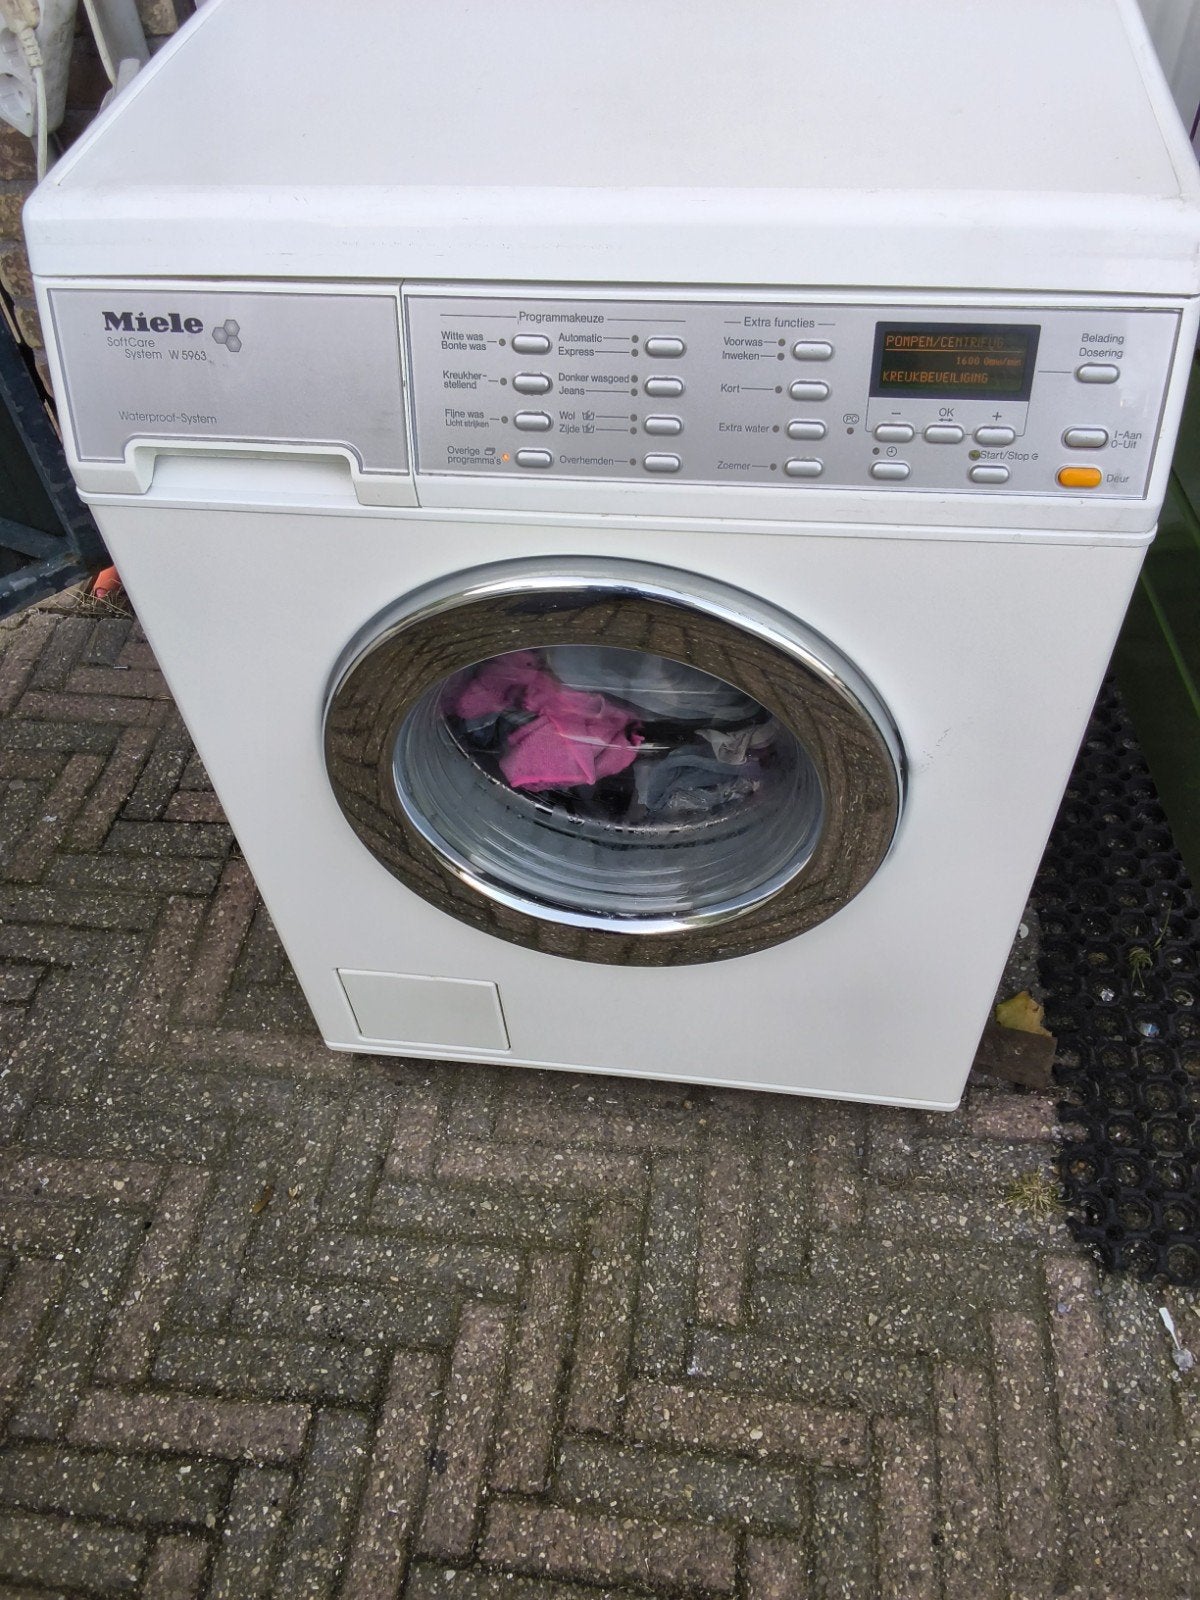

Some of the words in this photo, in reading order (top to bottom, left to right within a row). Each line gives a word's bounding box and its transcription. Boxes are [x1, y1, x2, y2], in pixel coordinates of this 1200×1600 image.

[102, 311, 204, 334] Miele
[519, 311, 605, 324] Programmakeuze
[743, 316, 771, 328] Extra
[774, 317, 815, 328] functies
[441, 330, 464, 341] Witte
[466, 333, 484, 341] was
[558, 332, 603, 343] Automatic
[1081, 332, 1125, 345] Belading
[107, 336, 155, 348] SoftCare
[441, 340, 467, 350] Bonte
[469, 343, 487, 351] was
[723, 336, 763, 347] Voorwas
[125, 348, 162, 360] System
[168, 350, 179, 360] W
[181, 350, 207, 361] 5963
[558, 346, 595, 357] Express
[722, 350, 760, 361] Inweken
[1079, 347, 1124, 359] Dosering
[955, 356, 980, 366] 1600
[442, 370, 487, 380] Kreukher-
[558, 372, 589, 382] Donker
[590, 374, 630, 385] wasgoed
[882, 370, 989, 384] KREUKBEVEILIGING
[444, 380, 477, 389] stellend
[720, 383, 740, 393] Kort
[558, 386, 585, 396] Jeans
[445, 408, 465, 419] Fijne
[467, 411, 485, 419] was
[559, 410, 576, 420] Wol
[938, 407, 955, 417] OK
[118, 411, 218, 425] Waterproof-System
[445, 419, 463, 427] Licht
[464, 420, 490, 429] strijken
[559, 423, 580, 435] Zijde
[718, 422, 742, 432] Extra
[745, 424, 770, 433] water
[447, 445, 480, 457] Overige
[980, 450, 1030, 462] Start/Stop
[447, 456, 502, 465] programma's
[560, 455, 614, 466] Overhemden
[717, 460, 751, 471] Zoemer
[1106, 473, 1130, 483] Deur
